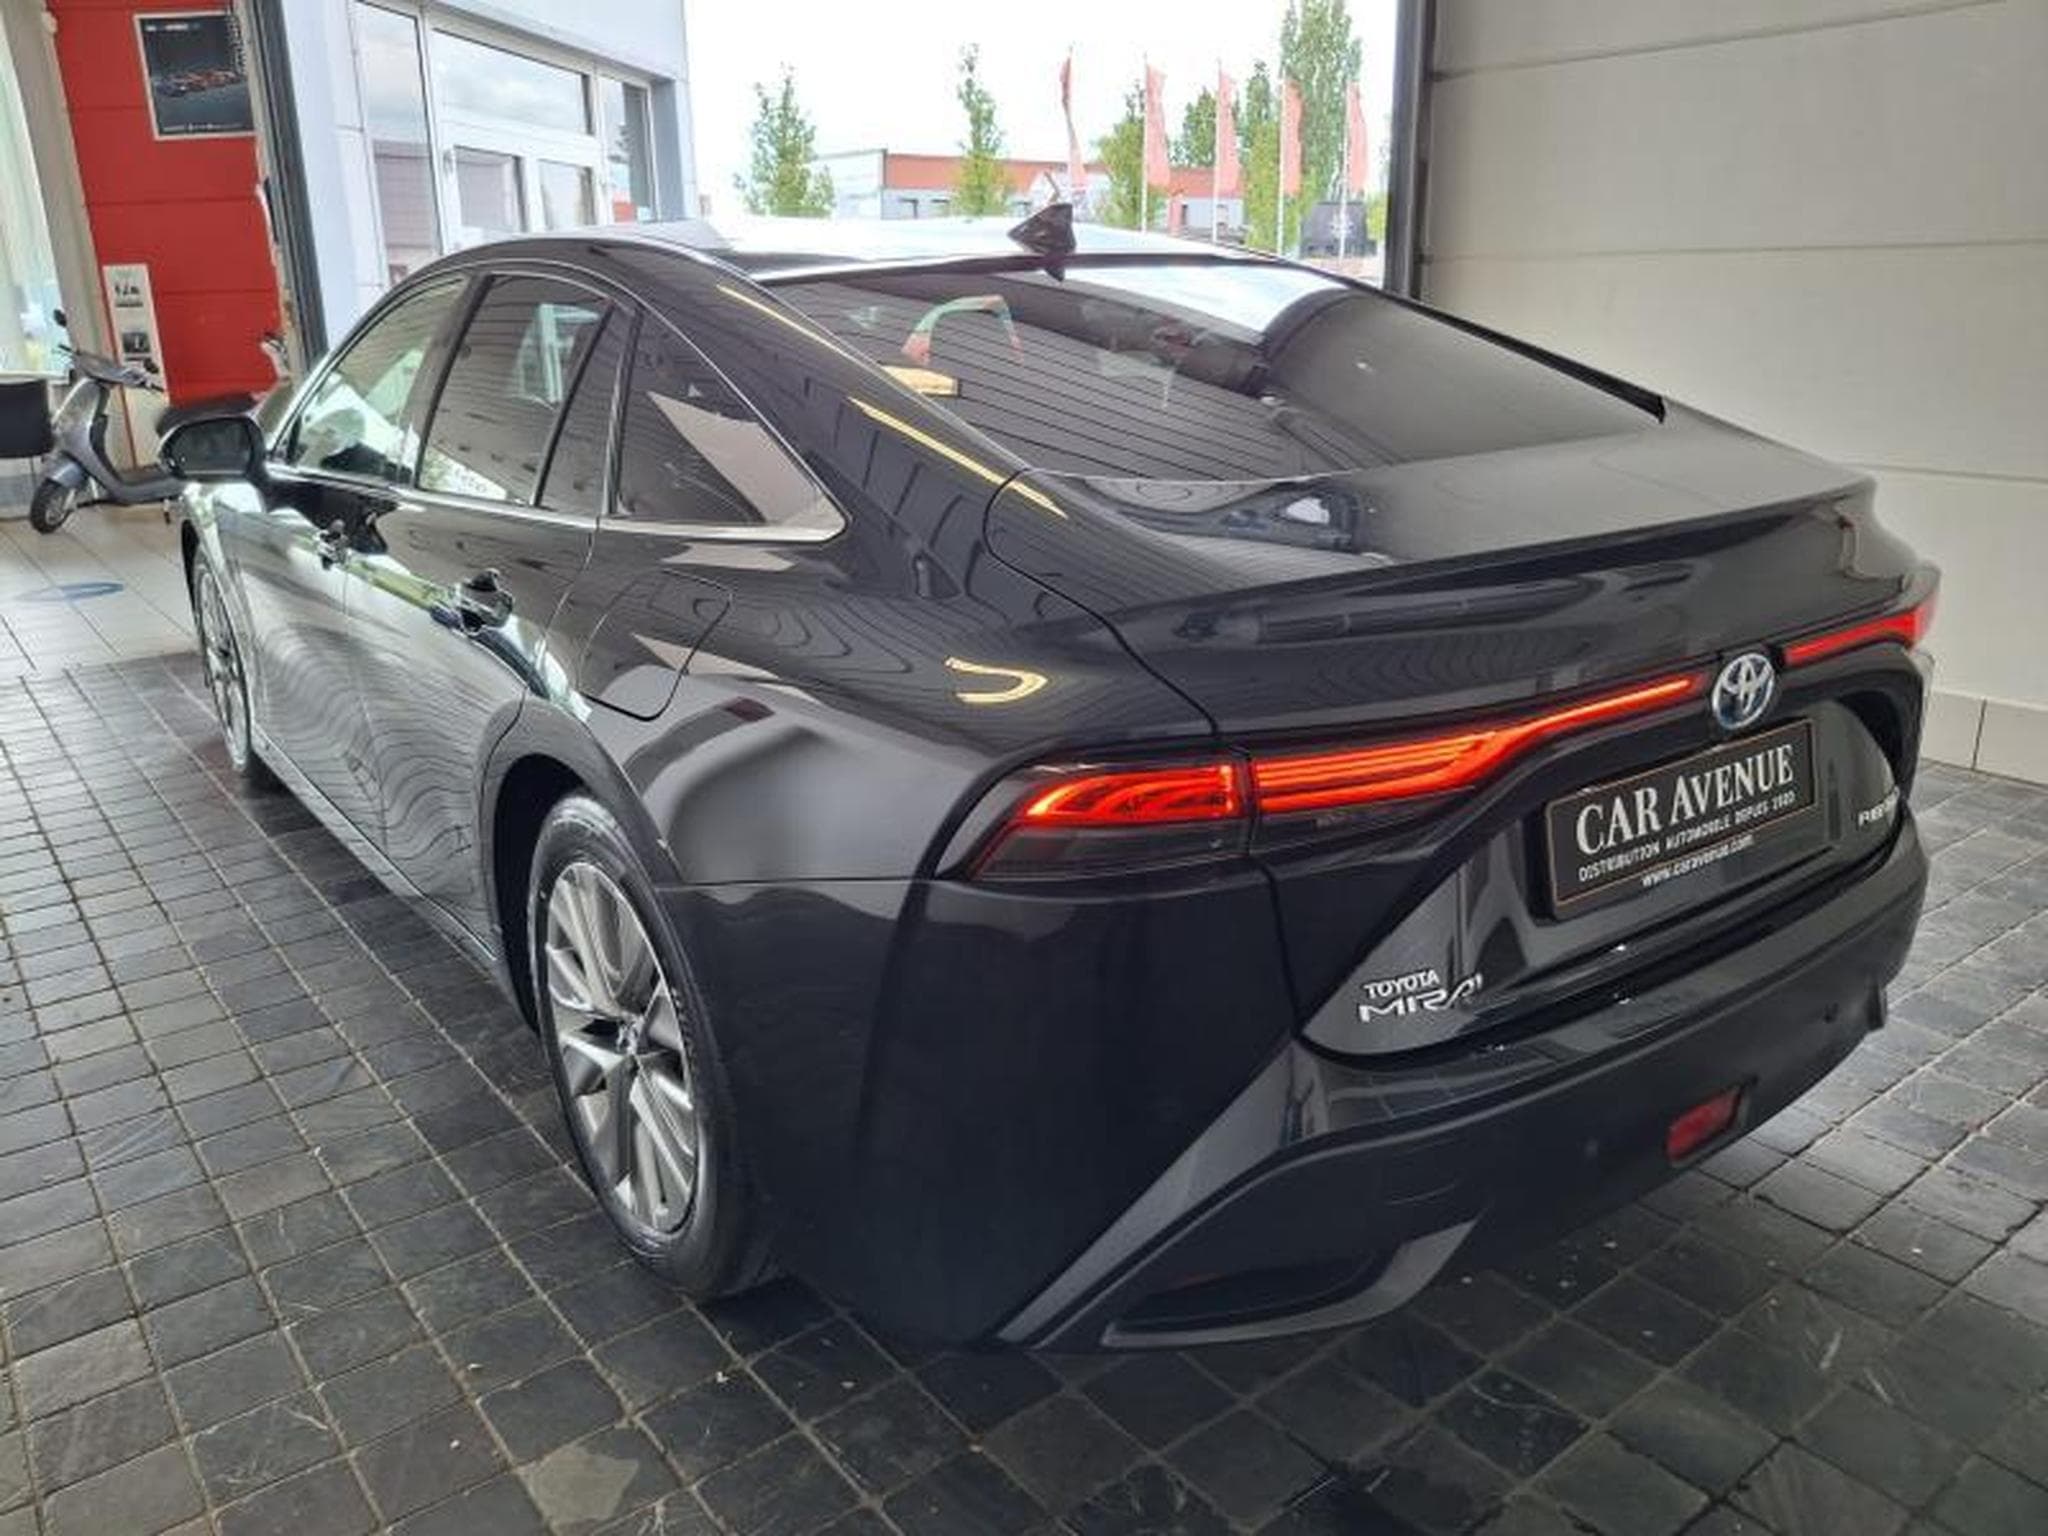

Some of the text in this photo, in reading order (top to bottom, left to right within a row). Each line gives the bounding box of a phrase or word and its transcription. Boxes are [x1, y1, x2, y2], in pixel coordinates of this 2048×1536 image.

[1576, 787, 1662, 855] CAR
[1669, 744, 1794, 825] AVENUE
[1579, 840, 1660, 882] DISTRIBUTION
[1665, 814, 1731, 850] AUTOMOBILE
[1642, 833, 1756, 887] www.caravenue.com
[1358, 972, 1483, 1023] MIRAI
[1363, 969, 1440, 1000] TOYOTA
